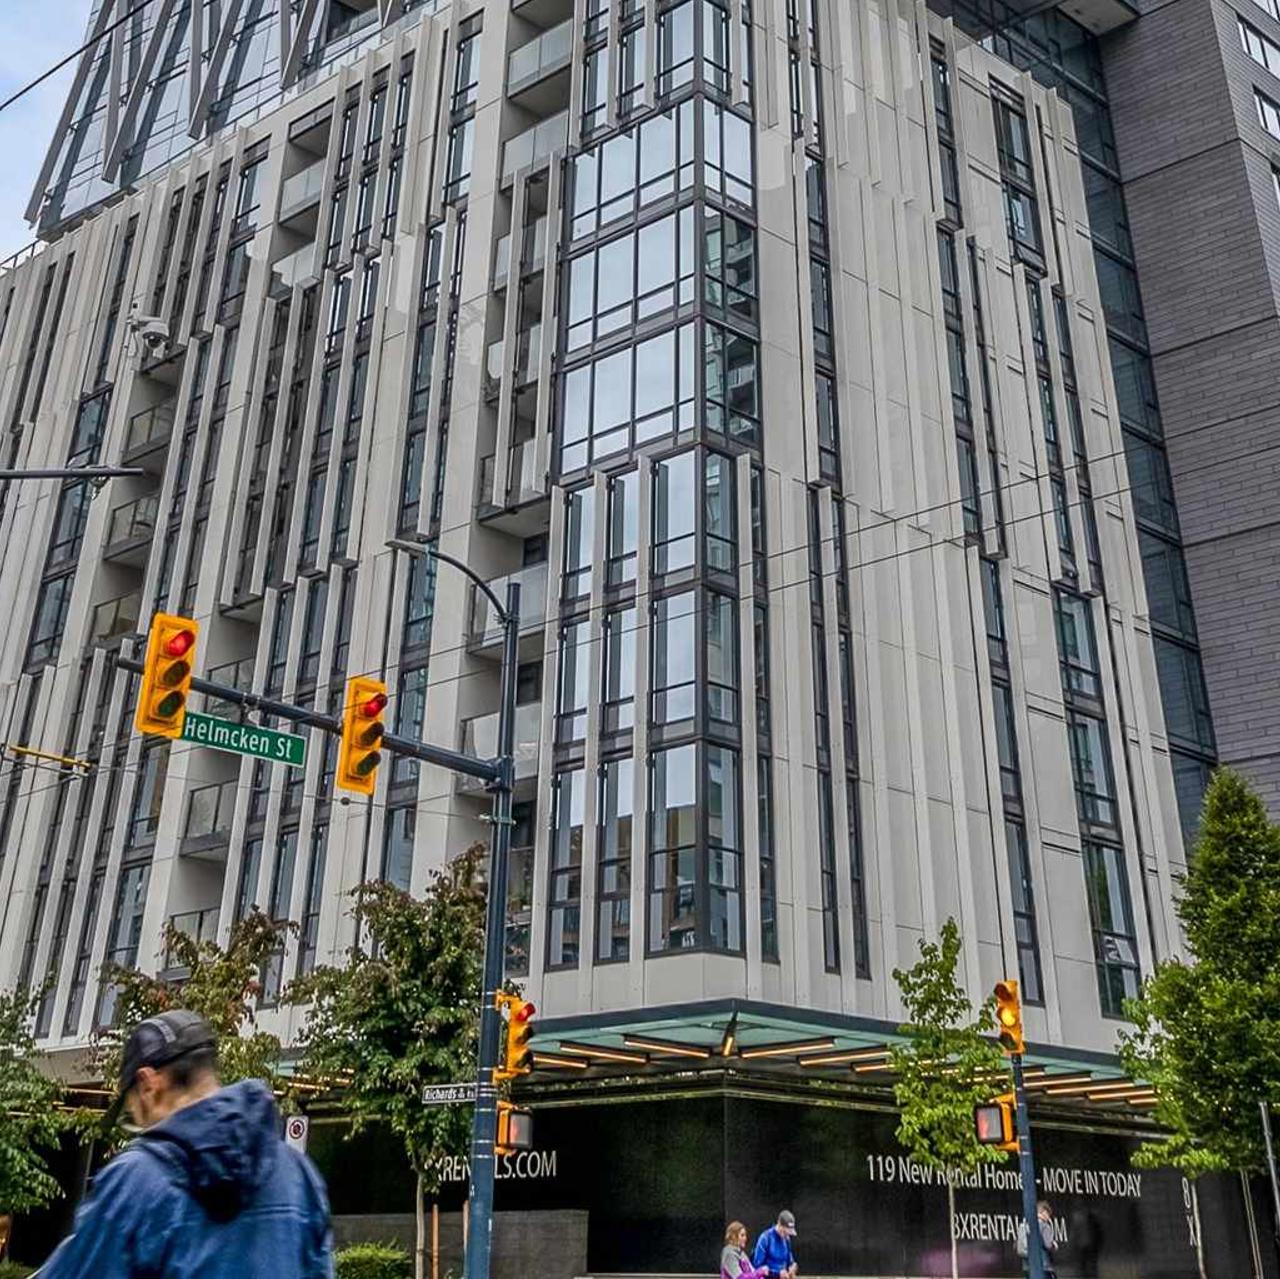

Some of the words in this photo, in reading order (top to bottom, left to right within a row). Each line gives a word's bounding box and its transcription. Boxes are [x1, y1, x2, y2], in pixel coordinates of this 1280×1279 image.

[184, 716, 269, 754] Helmcken
[276, 737, 292, 759] St
[867, 1154, 895, 1181] 119
[899, 1156, 933, 1185] New
[984, 1163, 1025, 1191] Home
[1043, 1167, 1083, 1194] MOVE
[1084, 1170, 1099, 1195] IN
[1099, 1171, 1142, 1198] TODAY
